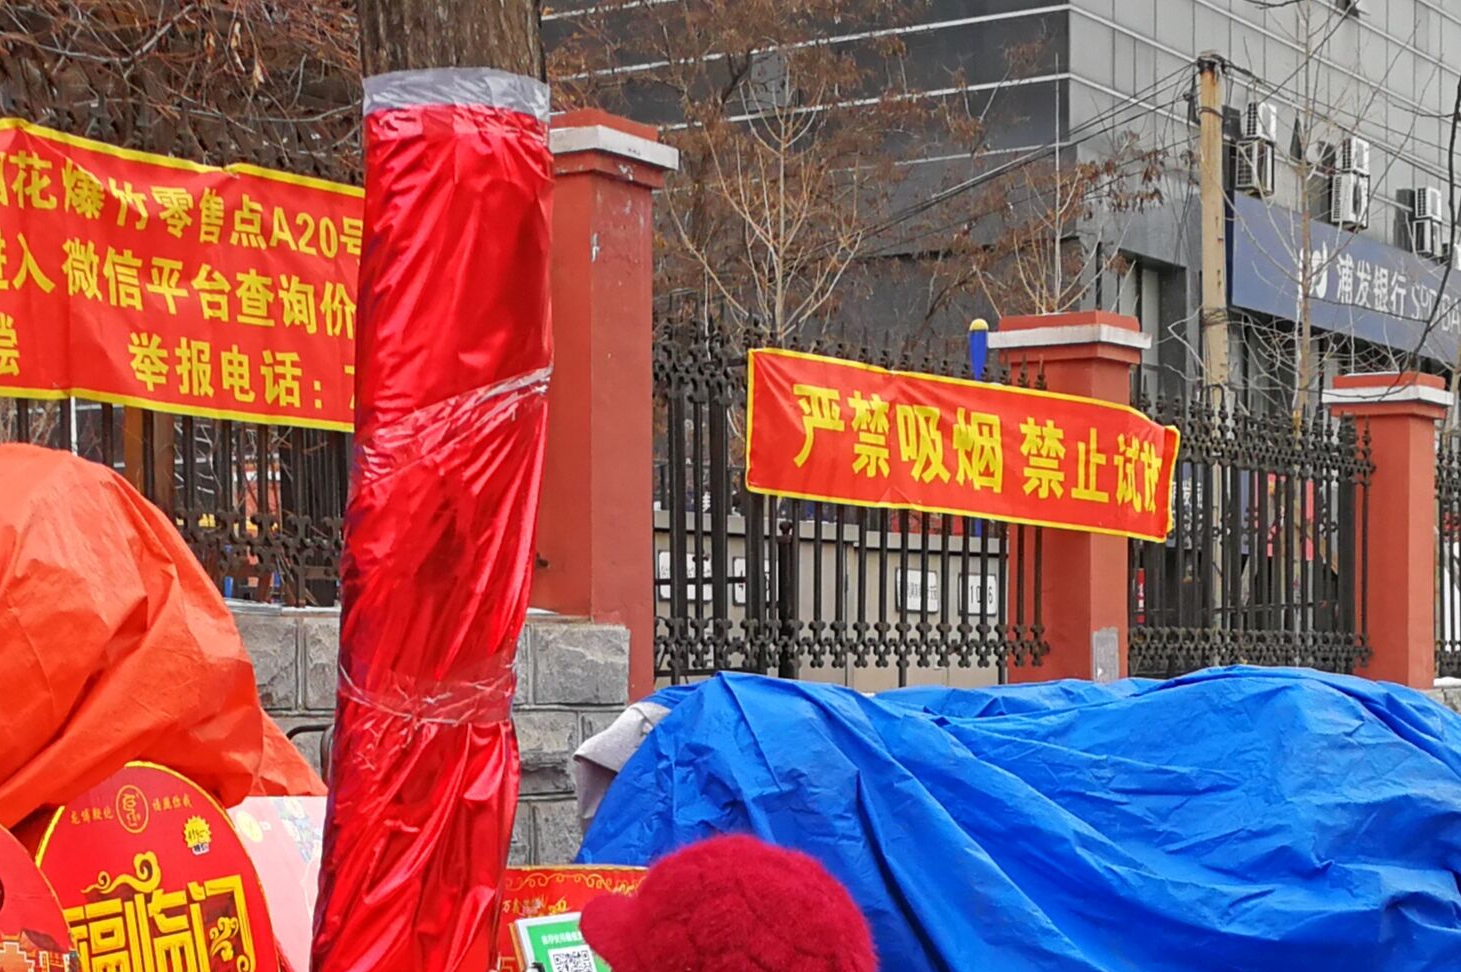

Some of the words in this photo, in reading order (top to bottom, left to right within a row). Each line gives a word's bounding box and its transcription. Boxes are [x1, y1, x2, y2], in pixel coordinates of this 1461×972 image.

[1336, 253, 1407, 320] 浦发银行
[792, 383, 1003, 494] 严禁吸烟
[1019, 416, 1163, 515] 禁止试放
